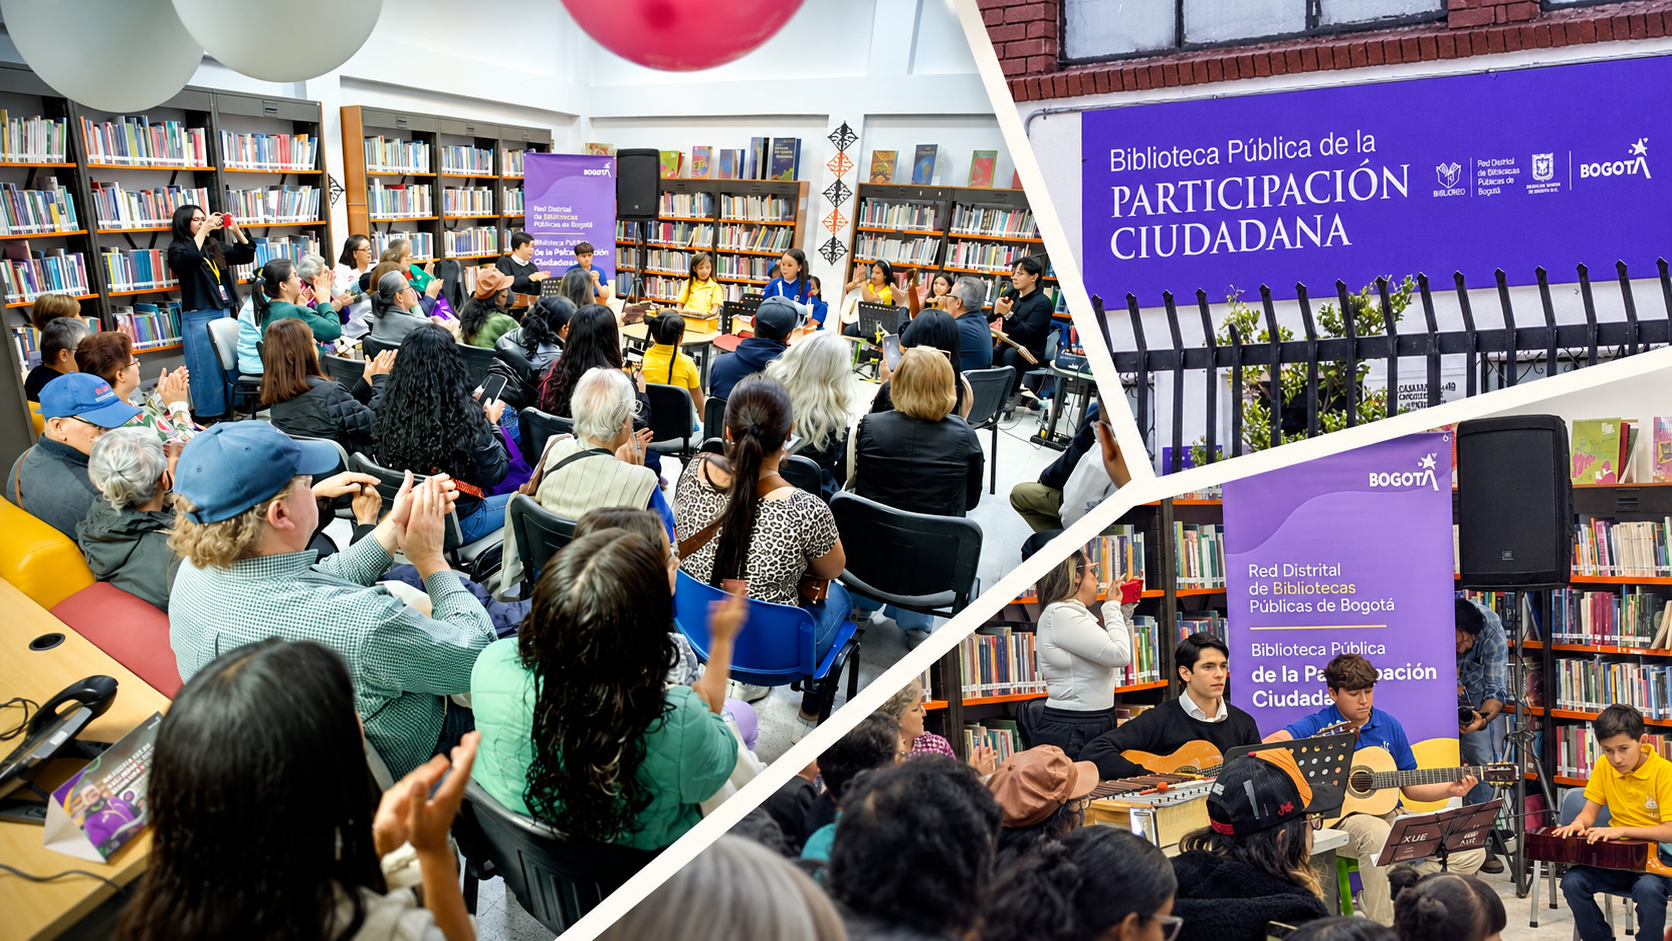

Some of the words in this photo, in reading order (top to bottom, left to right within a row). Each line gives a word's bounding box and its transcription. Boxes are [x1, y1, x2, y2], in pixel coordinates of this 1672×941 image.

[1110, 146, 1220, 172] Biblioteca
[1228, 136, 1312, 163] Pública
[1320, 132, 1349, 156] de
[1356, 130, 1376, 154] la
[1111, 158, 1410, 218] PARTICIPACIÓN
[1110, 213, 1352, 260] CIUDADANA
[1249, 564, 1278, 577] Red
[1283, 563, 1341, 577] Distrital
[1249, 582, 1268, 595] de
[1273, 582, 1356, 594] Bibliotecas
[1250, 599, 1313, 613] Públicas
[1316, 599, 1336, 612] de
[1341, 598, 1395, 615] Bogotá
[1252, 643, 1326, 656] Biblioteca
[1331, 642, 1386, 655] Pública
[1252, 666, 1277, 683] de
[1282, 665, 1298, 682] la
[1252, 690, 1336, 707] Ciudada
[1402, 833, 1428, 844] XUE
